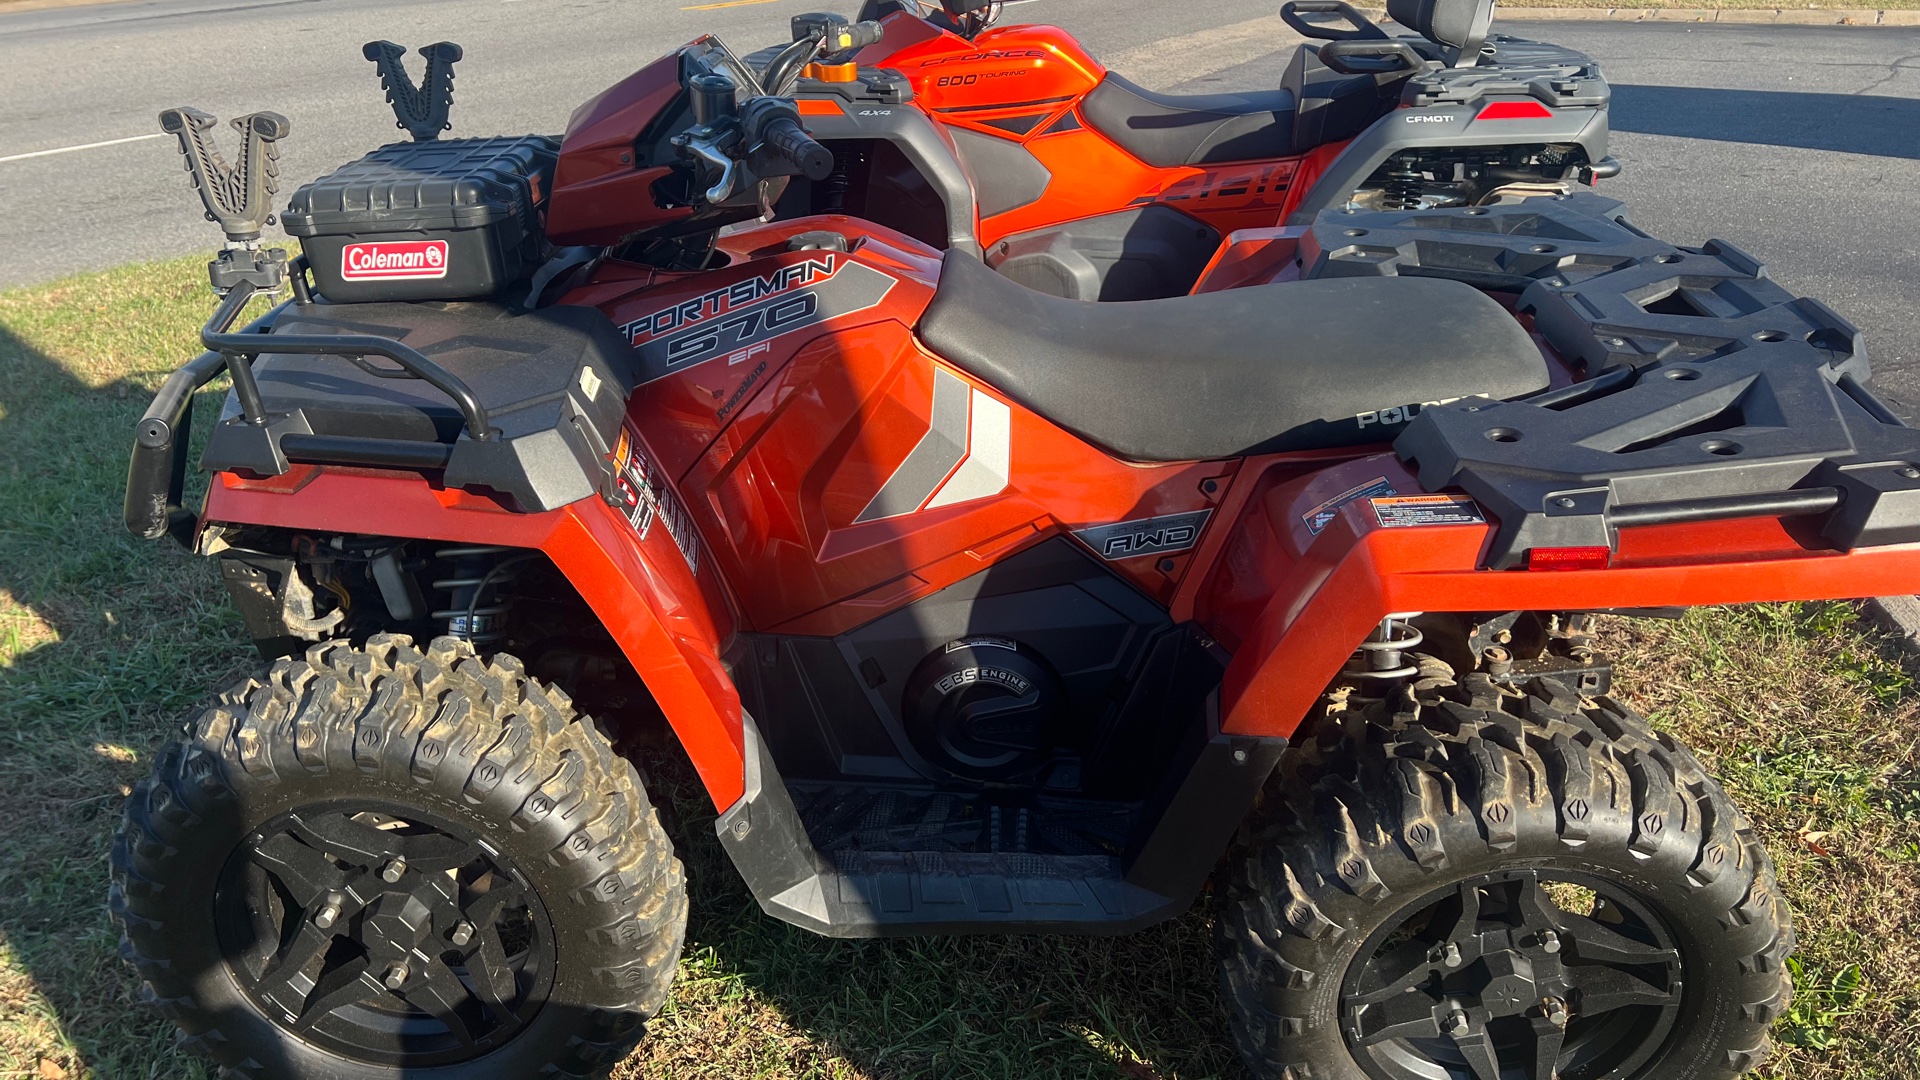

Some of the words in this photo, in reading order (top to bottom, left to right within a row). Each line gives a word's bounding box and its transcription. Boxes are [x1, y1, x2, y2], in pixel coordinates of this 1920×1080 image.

[920, 51, 1046, 68] CFORCE
[937, 74, 978, 87] 800
[979, 70, 1027, 79] TOURING
[349, 247, 425, 270] Coleman
[666, 291, 818, 367] 570
[728, 341, 771, 367] EFI
[1103, 525, 1196, 556] AWD
[939, 668, 977, 691] EBS
[981, 669, 1027, 689] ENGINE
